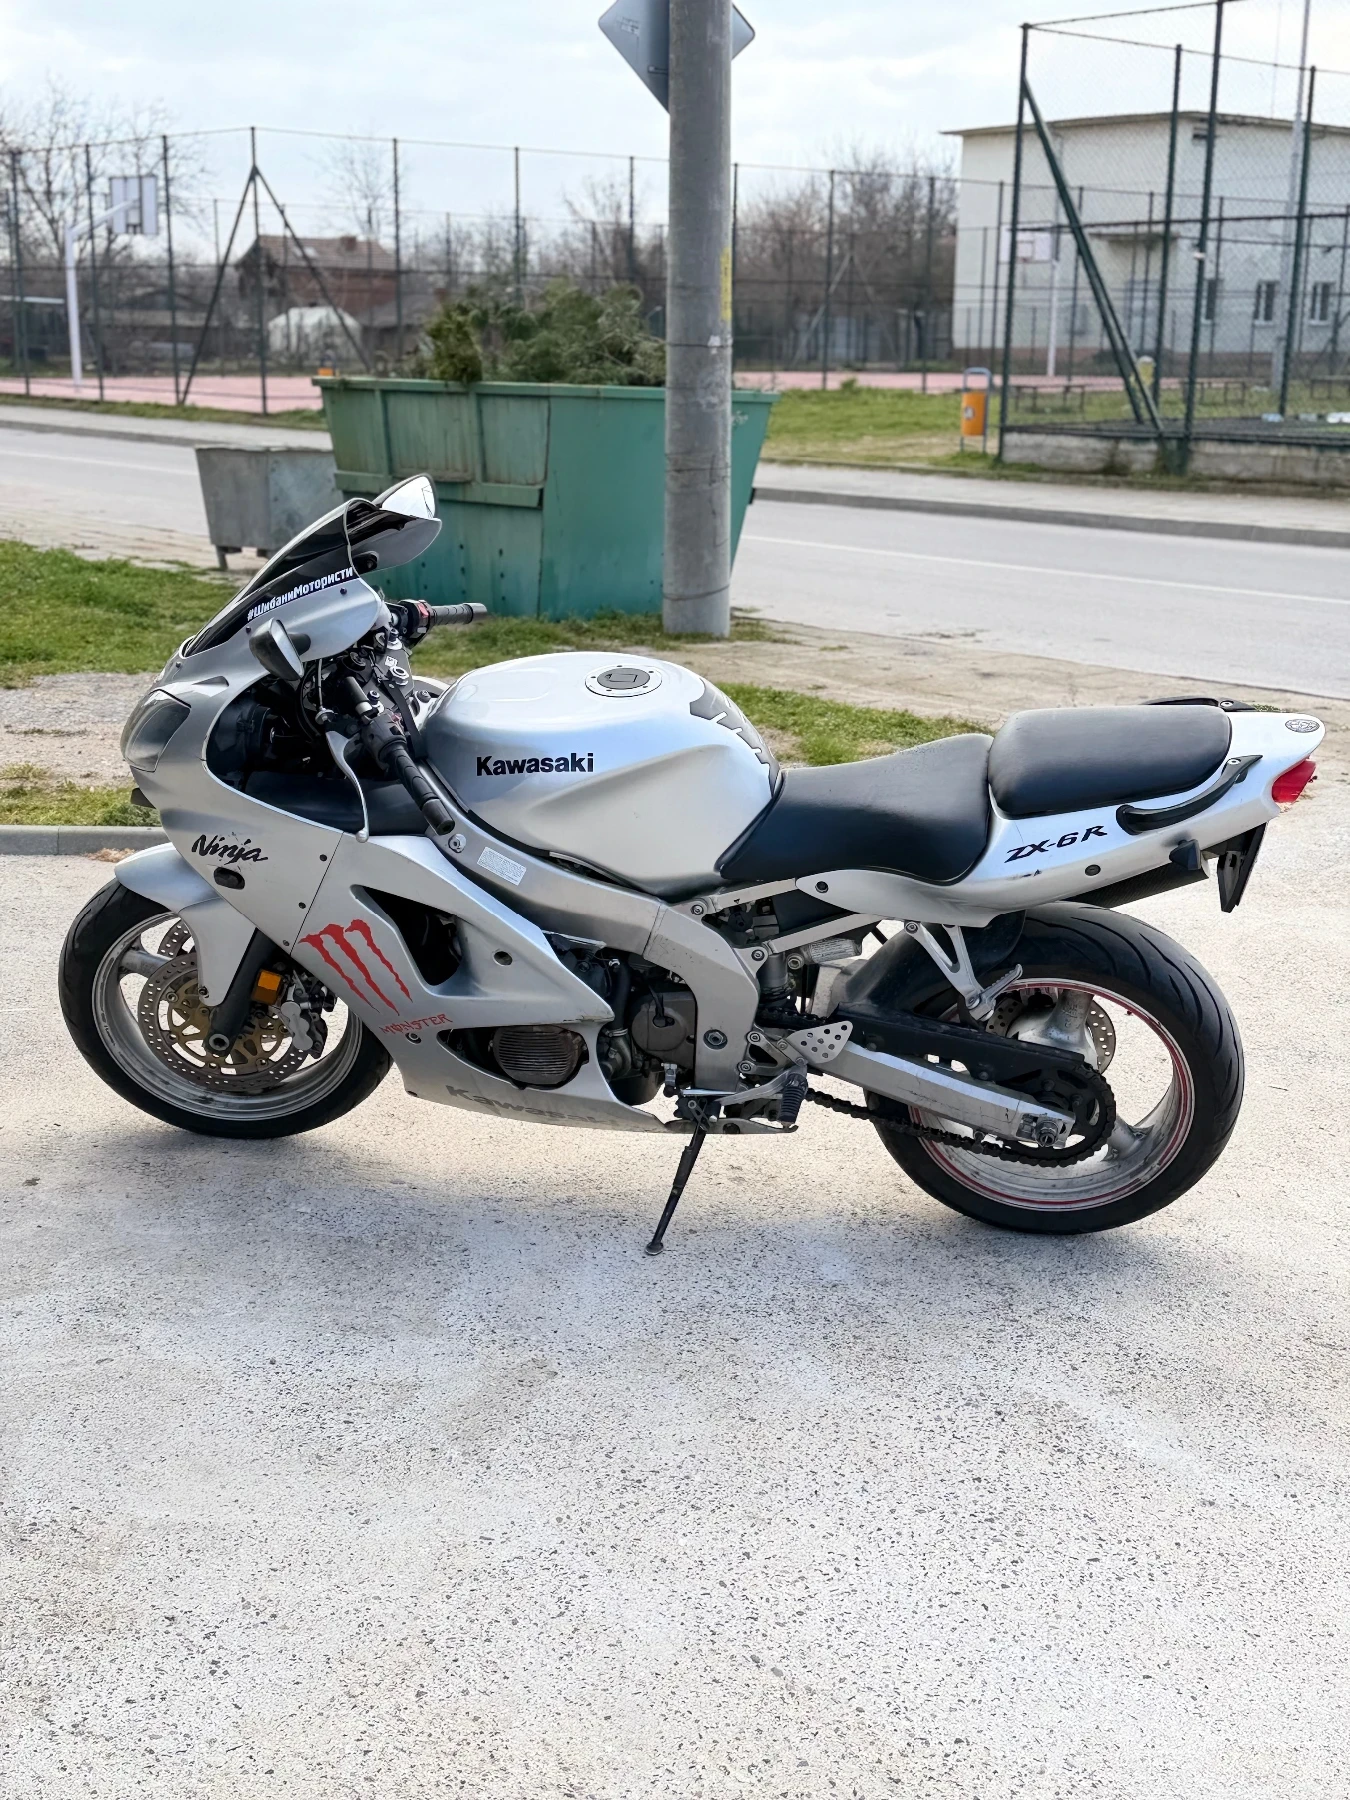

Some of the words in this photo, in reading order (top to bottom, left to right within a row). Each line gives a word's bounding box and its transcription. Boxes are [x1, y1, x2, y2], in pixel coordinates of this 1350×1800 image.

[476, 752, 594, 776] Kawasaki
[191, 834, 268, 866] Ninja
[379, 1014, 453, 1034] MONSTER
[446, 1084, 620, 1126] Kawasa
